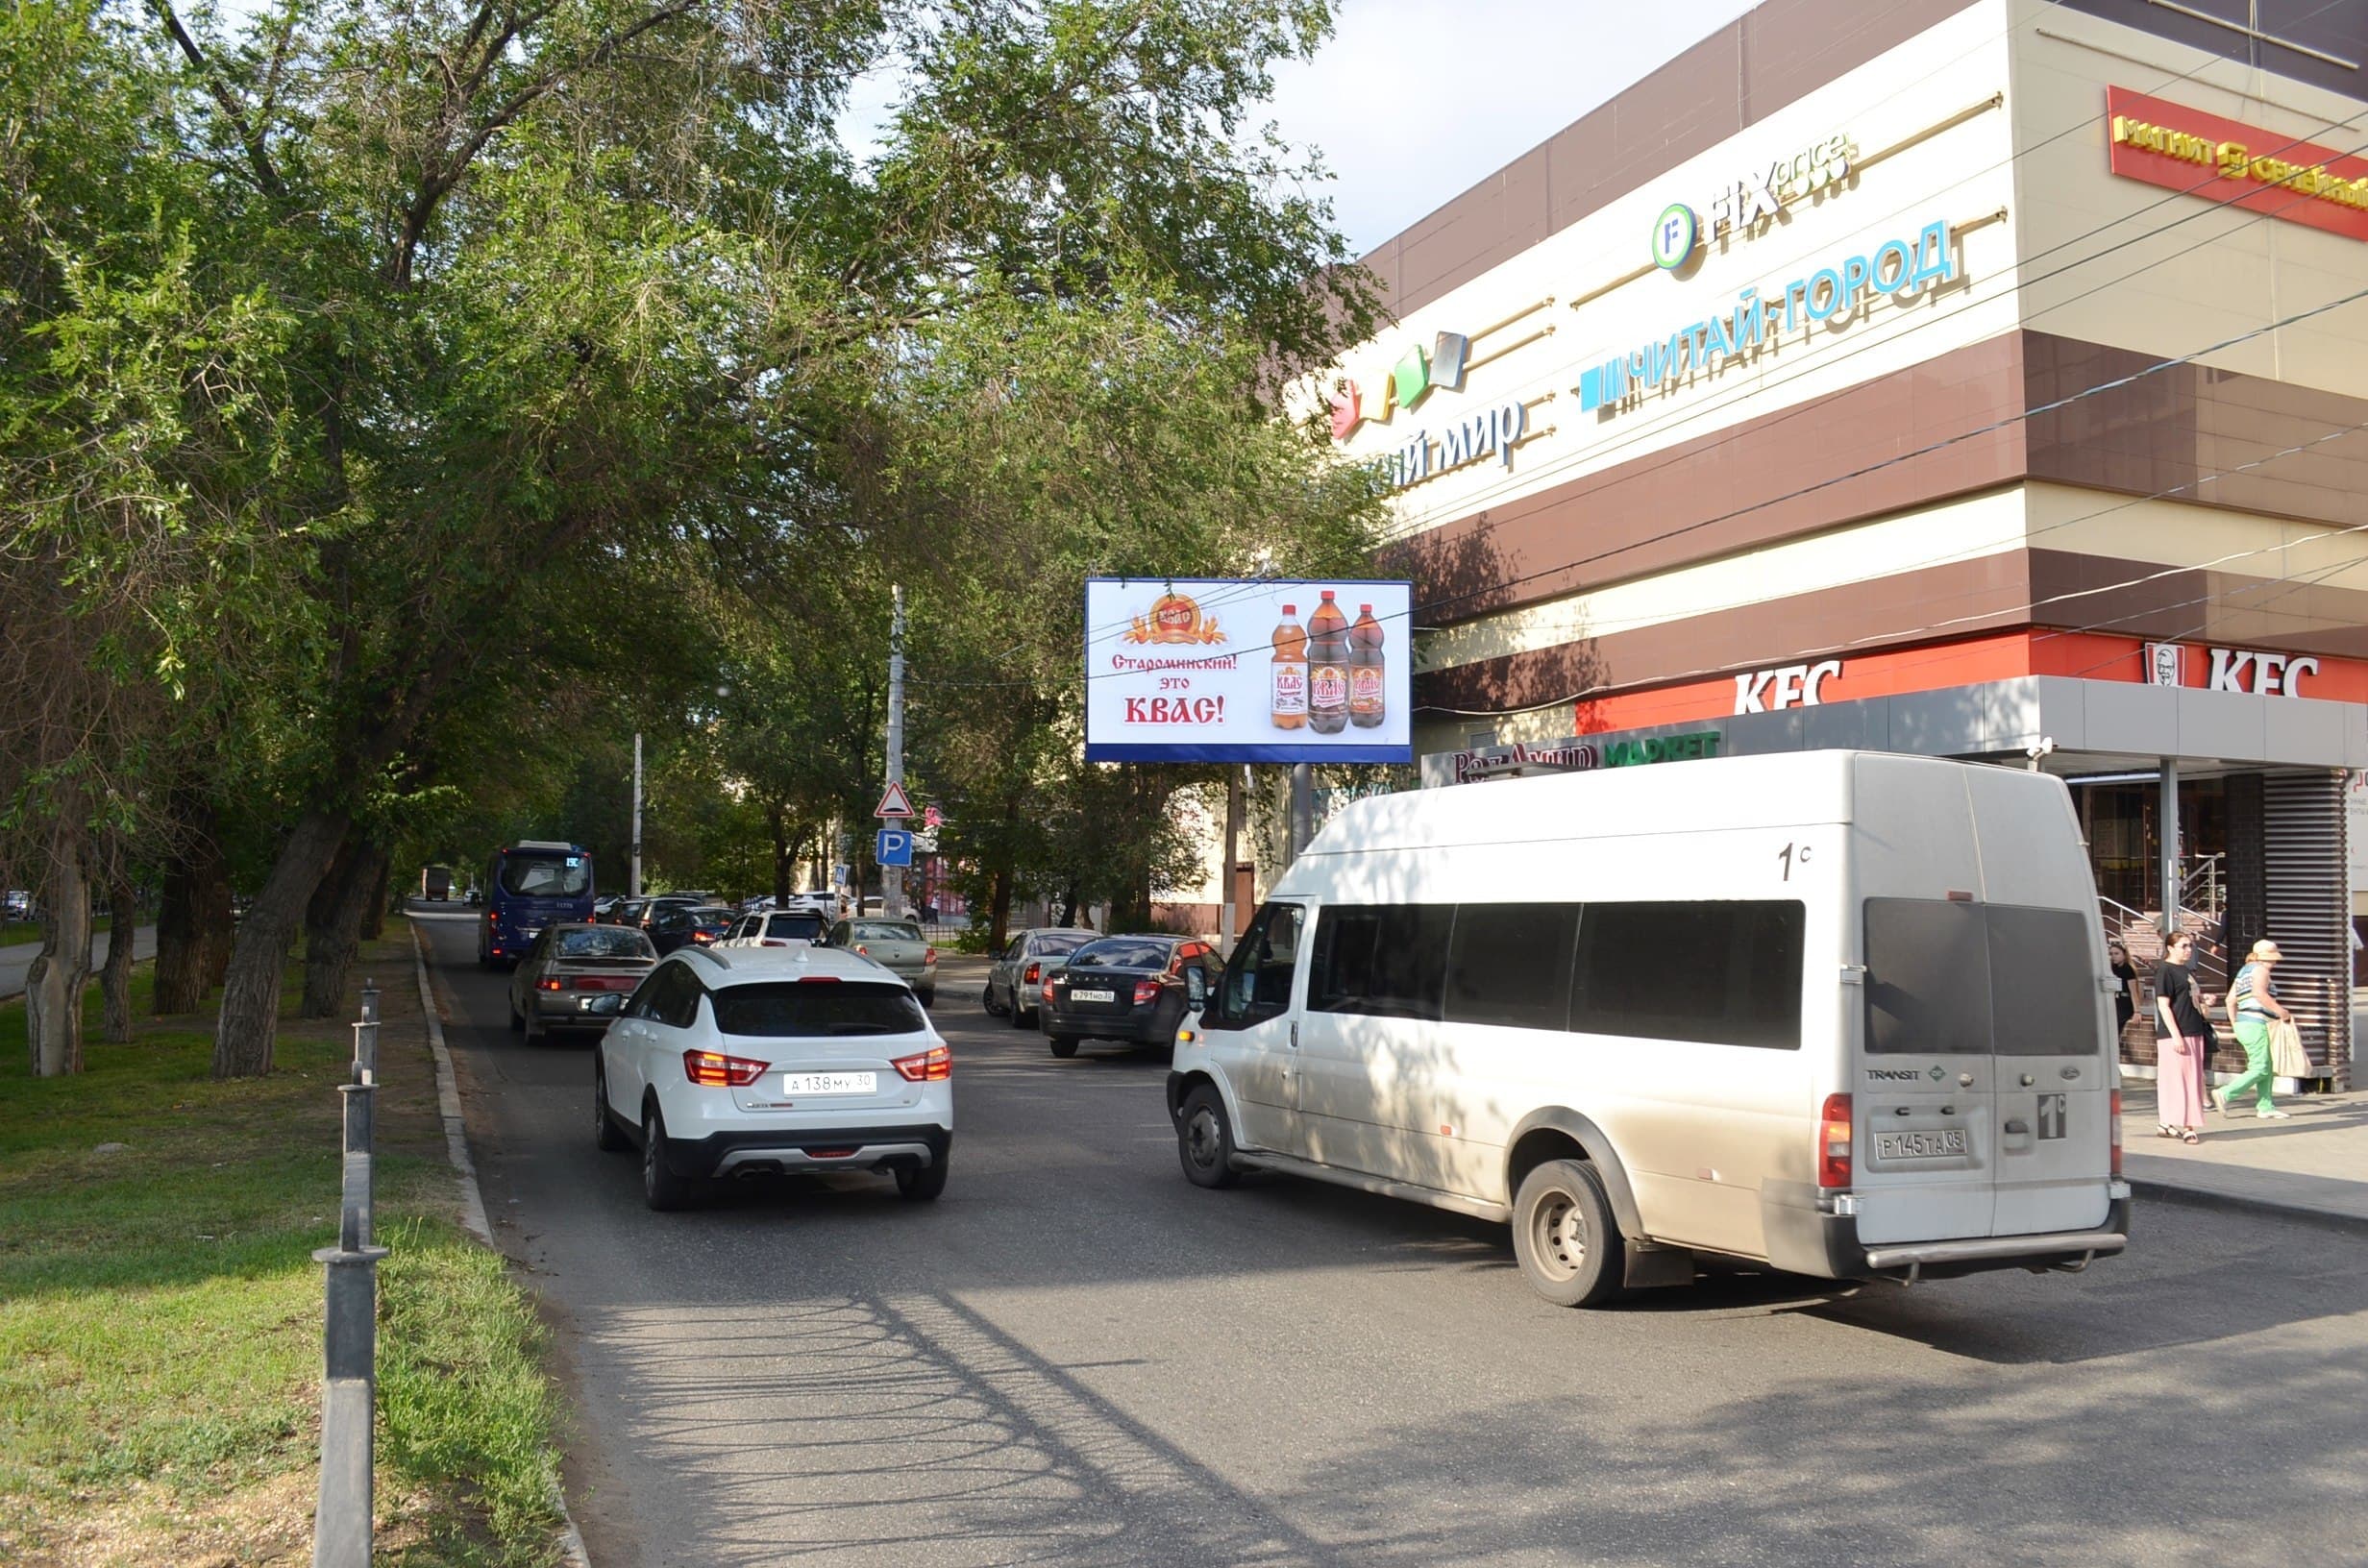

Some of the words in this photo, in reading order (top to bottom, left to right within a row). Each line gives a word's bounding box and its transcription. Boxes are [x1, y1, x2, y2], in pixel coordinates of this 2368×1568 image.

[1734, 660, 1840, 715] KFC
[2209, 648, 2318, 698] KFC
[1123, 695, 1225, 723] КВАС!
[1867, 1069, 1920, 1081] TRANSIT
